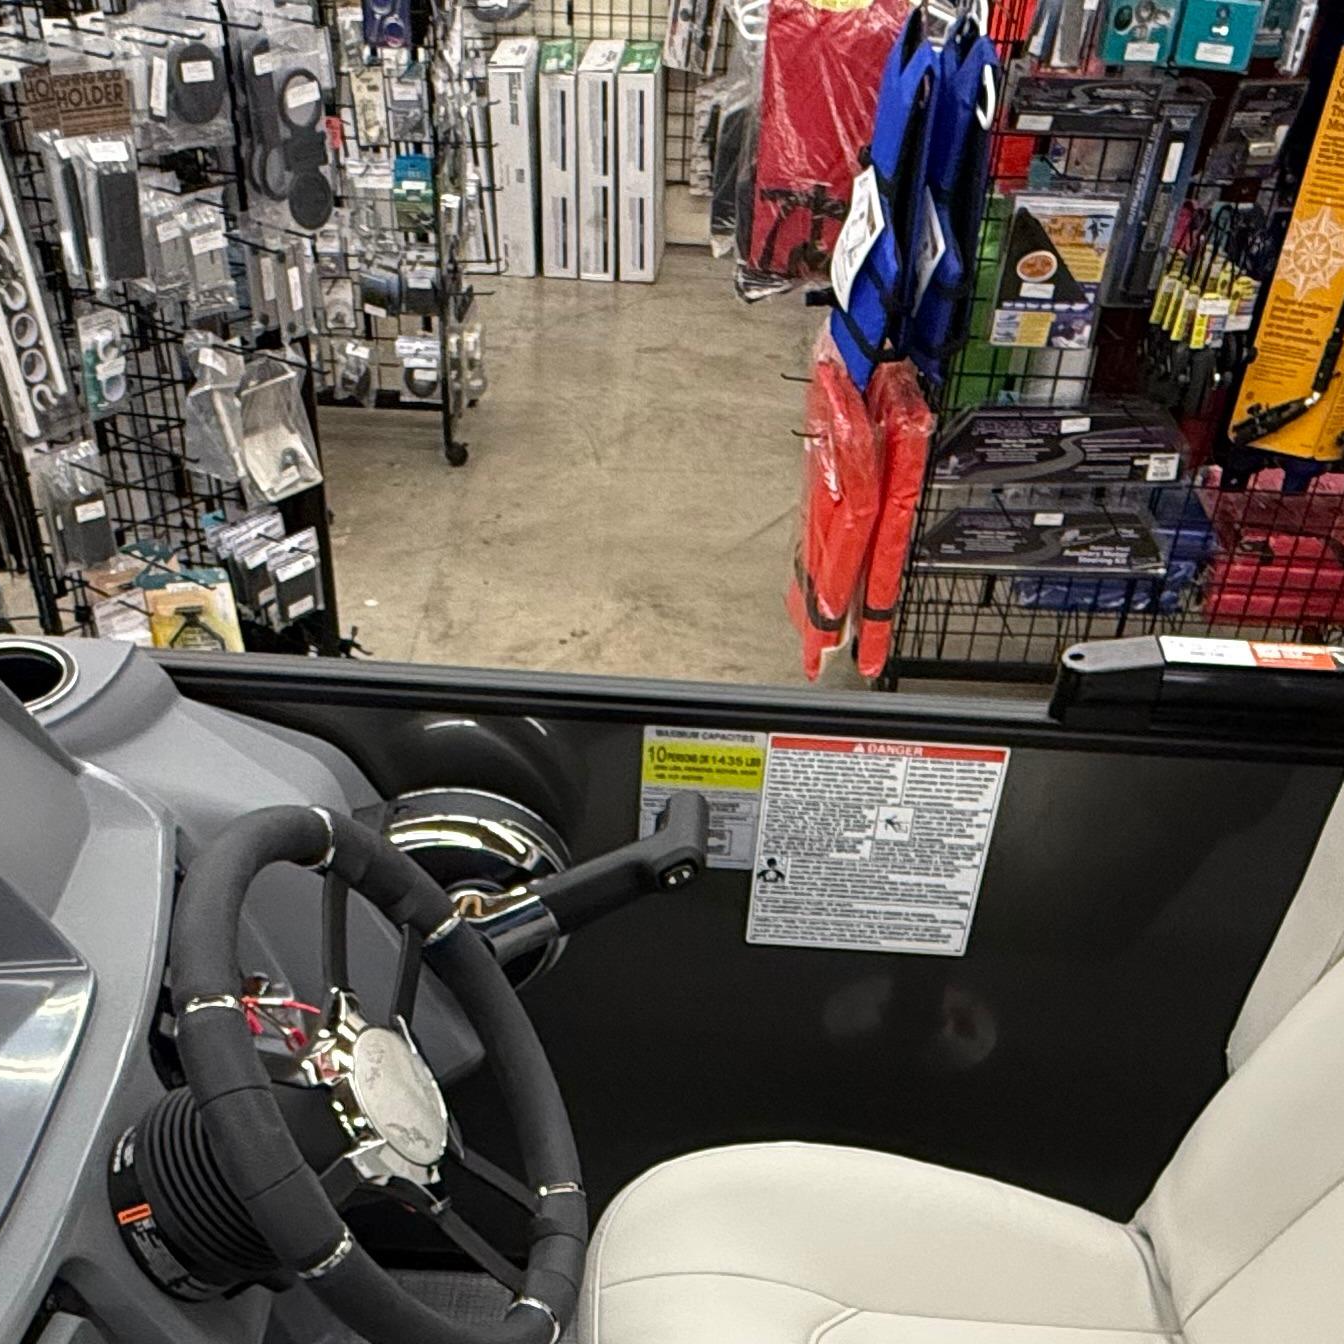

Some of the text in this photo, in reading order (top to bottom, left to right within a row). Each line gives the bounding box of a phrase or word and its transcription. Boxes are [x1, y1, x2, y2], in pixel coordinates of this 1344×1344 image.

[56, 82, 124, 109] HOLDER
[648, 745, 667, 763] 10
[712, 755, 743, 766] 1435
[867, 743, 924, 757] DANGER
